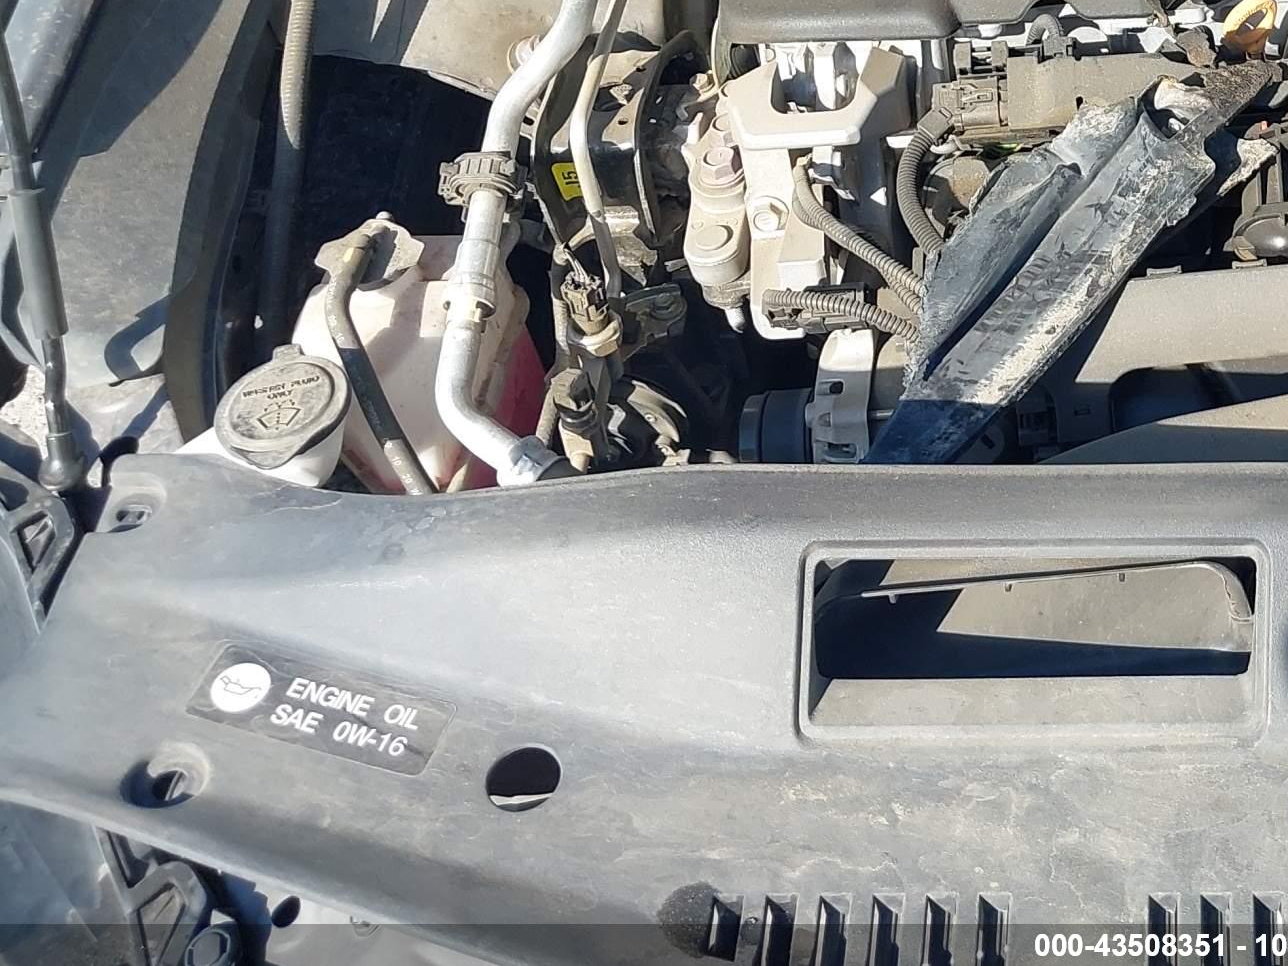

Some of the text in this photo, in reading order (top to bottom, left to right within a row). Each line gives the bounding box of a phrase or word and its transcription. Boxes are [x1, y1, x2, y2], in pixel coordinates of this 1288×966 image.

[286, 677, 419, 730] ENGINE OIL
[270, 704, 409, 757] SAE 0W-16
